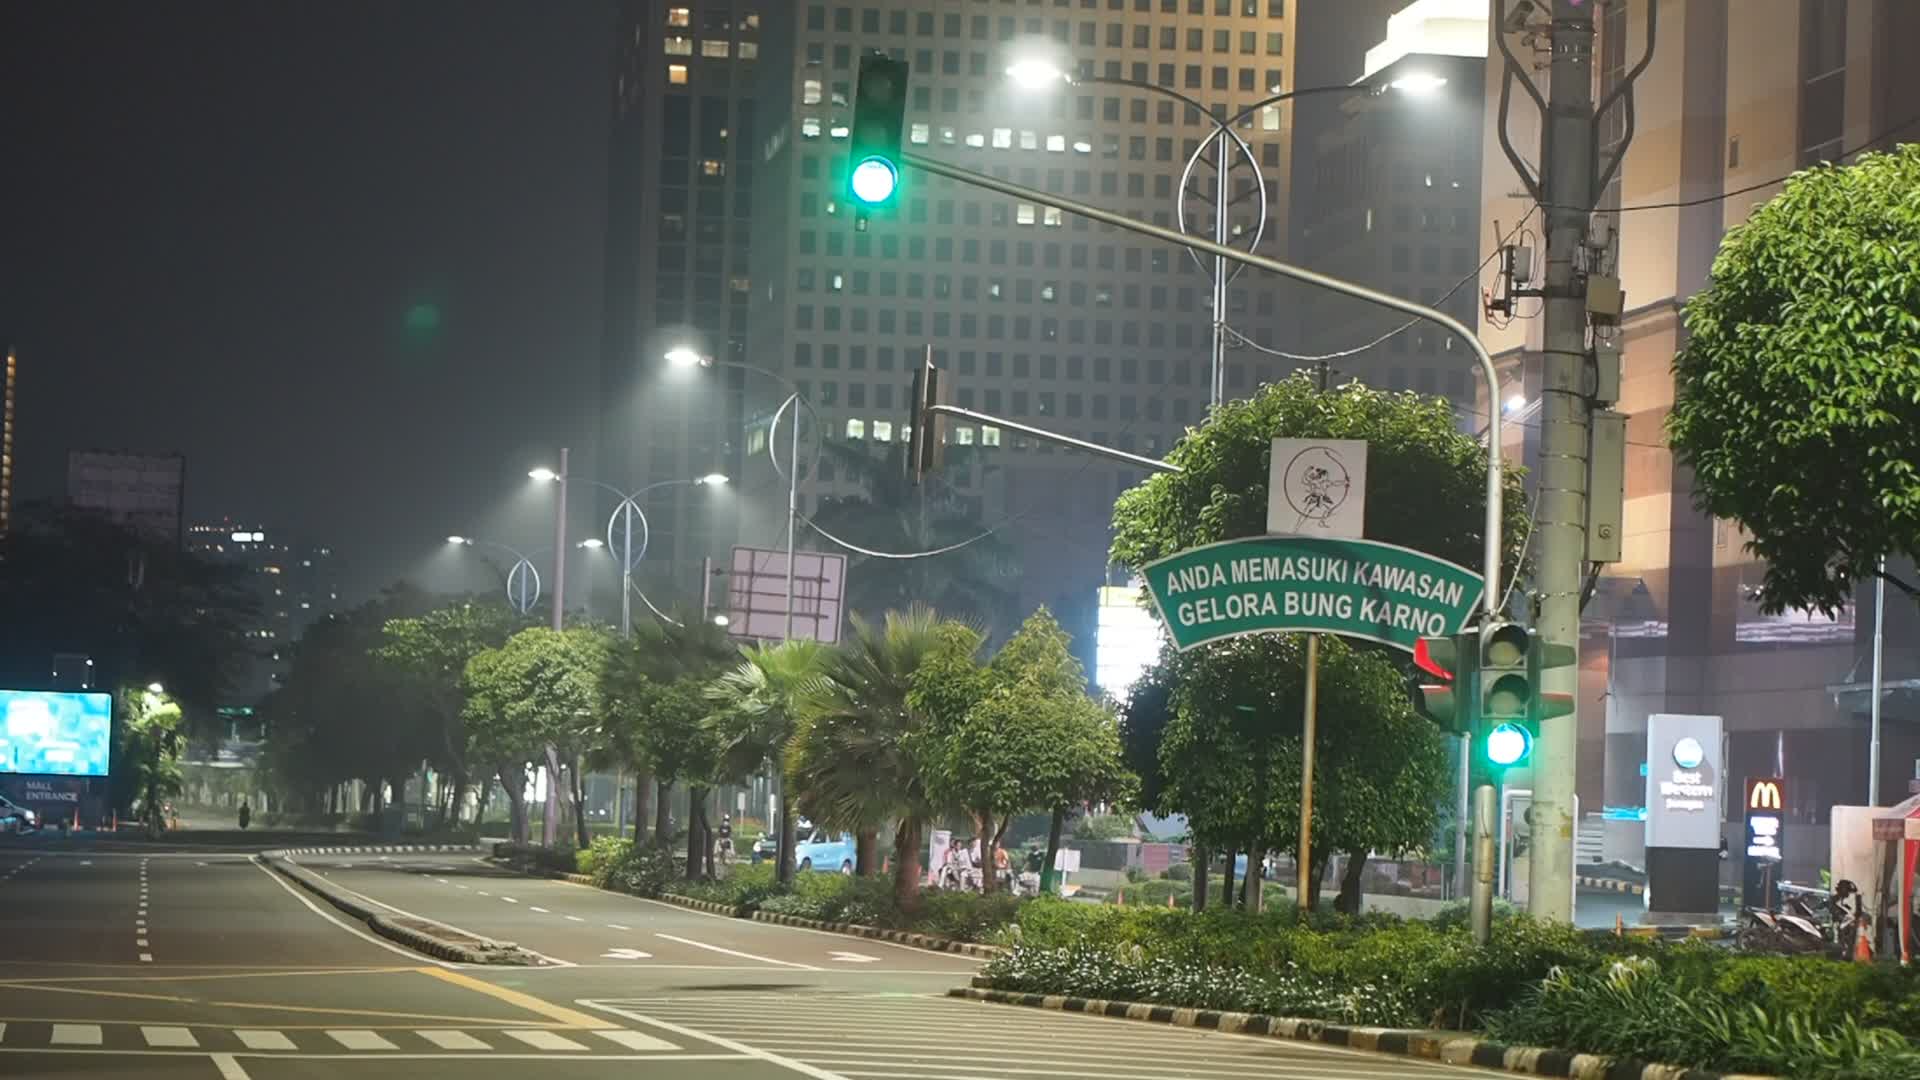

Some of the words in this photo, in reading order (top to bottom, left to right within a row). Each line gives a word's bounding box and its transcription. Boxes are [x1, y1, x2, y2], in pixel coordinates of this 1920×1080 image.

[1167, 563, 1228, 597] ANDA
[1231, 557, 1348, 584] MEMASUKI
[1353, 561, 1464, 608] KAWASAN
[1178, 592, 1279, 626] GELORA
[1284, 592, 1353, 619] BUNG
[1360, 597, 1446, 637] KARNO
[26, 781, 53, 791] MALL
[26, 791, 78, 802] ENTRANCE
